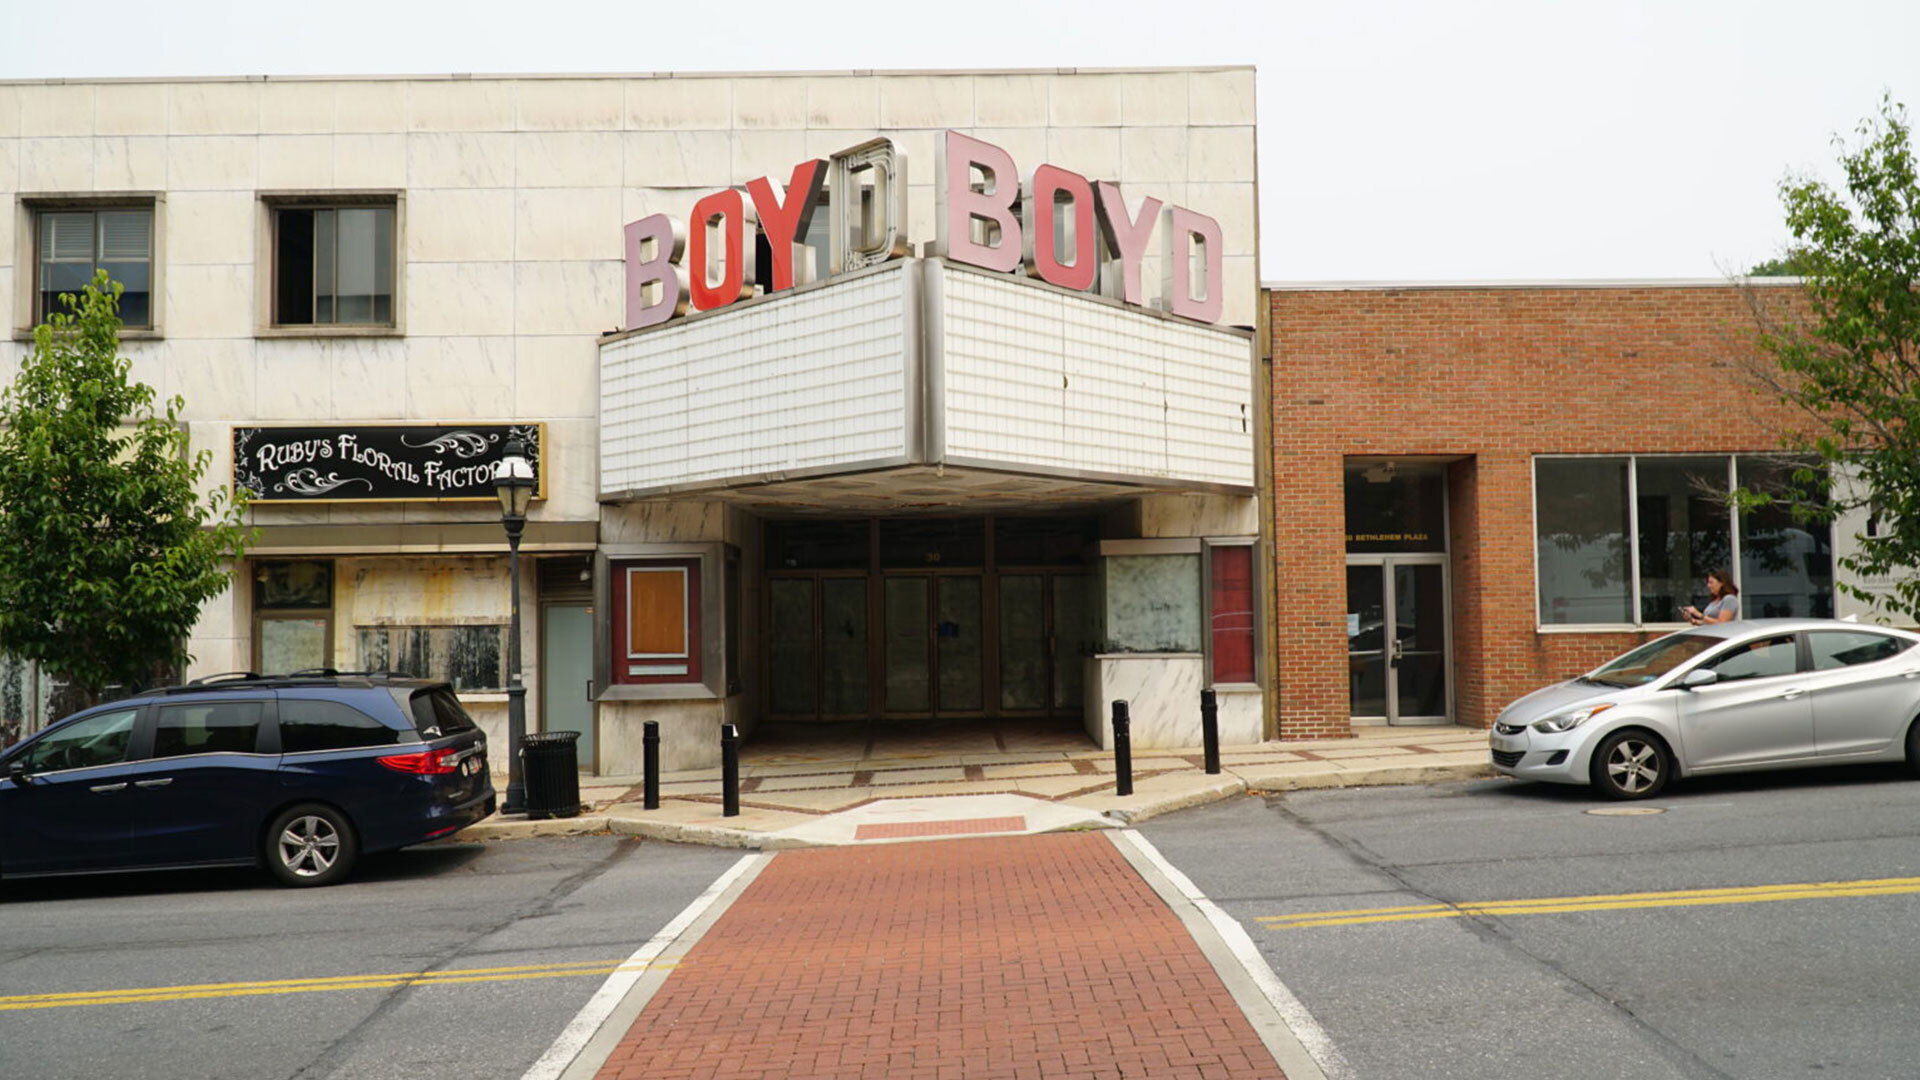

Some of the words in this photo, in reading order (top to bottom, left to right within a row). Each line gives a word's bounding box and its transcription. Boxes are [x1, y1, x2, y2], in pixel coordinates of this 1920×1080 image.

[624, 137, 908, 331] BOYD
[942, 130, 1222, 324] BOYD
[338, 434, 420, 483] FLORAL
